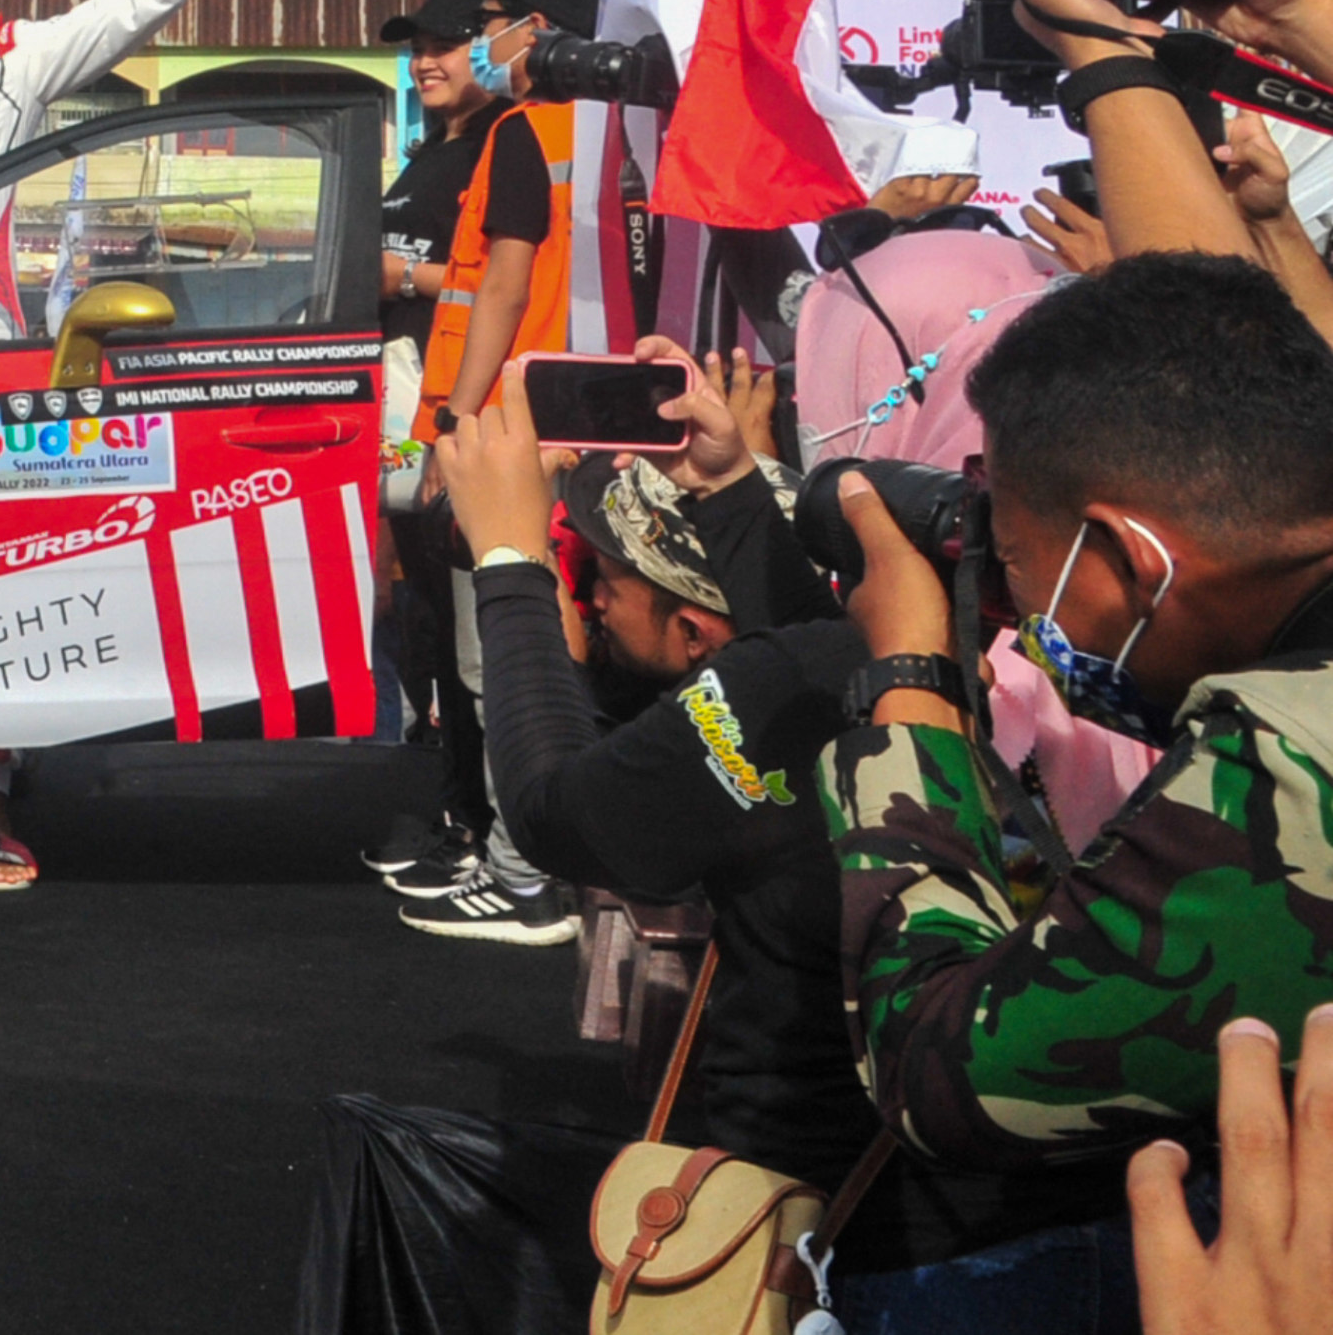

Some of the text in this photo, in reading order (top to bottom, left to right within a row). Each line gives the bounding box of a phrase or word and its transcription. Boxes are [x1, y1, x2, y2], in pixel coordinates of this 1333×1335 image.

[629, 213, 646, 276] SONY
[118, 343, 382, 371] FIA ASIA PACIFIC RALLY CHAMPIONSHIP
[115, 380, 358, 408] IMI NATIONAL RALLY CHAMPIONSHIP
[12, 452, 149, 473] Sumatera Utara
[22, 478, 50, 489] 2022
[90, 474, 130, 485] September
[190, 467, 293, 520] PASEO
